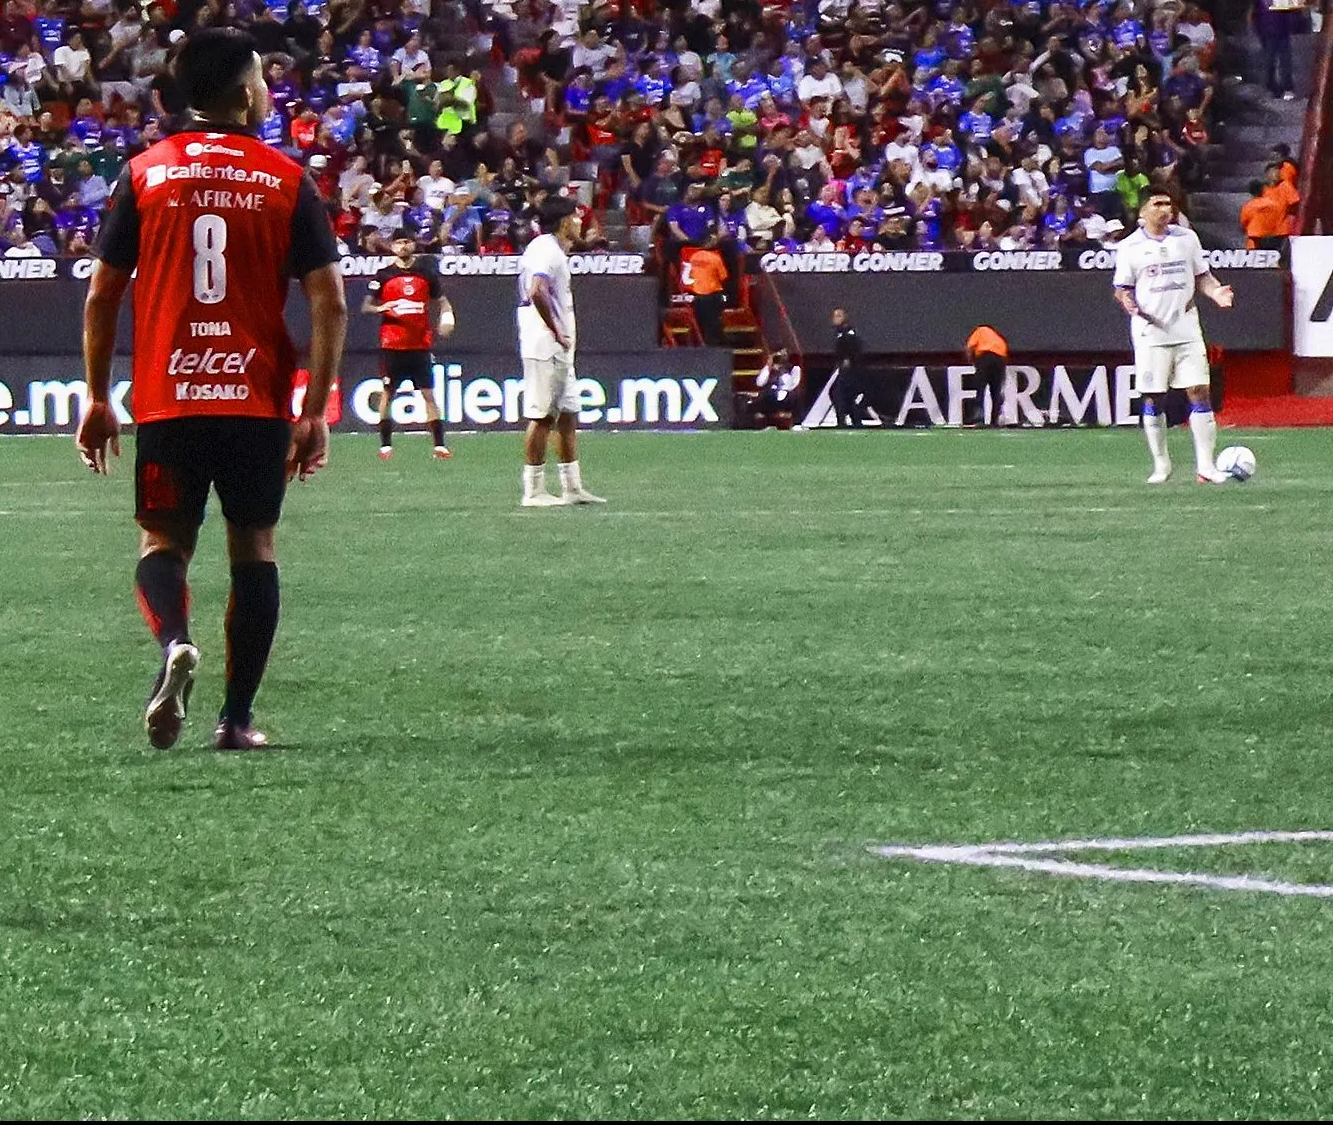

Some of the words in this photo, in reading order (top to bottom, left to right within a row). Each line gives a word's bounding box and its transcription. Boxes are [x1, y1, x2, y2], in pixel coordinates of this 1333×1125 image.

[167, 162, 282, 190] caliente.mx
[190, 190, 264, 211] AFIRME
[193, 214, 227, 304] 8
[440, 255, 522, 275] GONHE
[566, 254, 645, 274] ONHER
[761, 253, 850, 272] GONHER
[853, 252, 944, 271] GONHER
[973, 251, 1063, 270] GONHER
[190, 321, 231, 336] TONA
[168, 347, 257, 375] telcel
